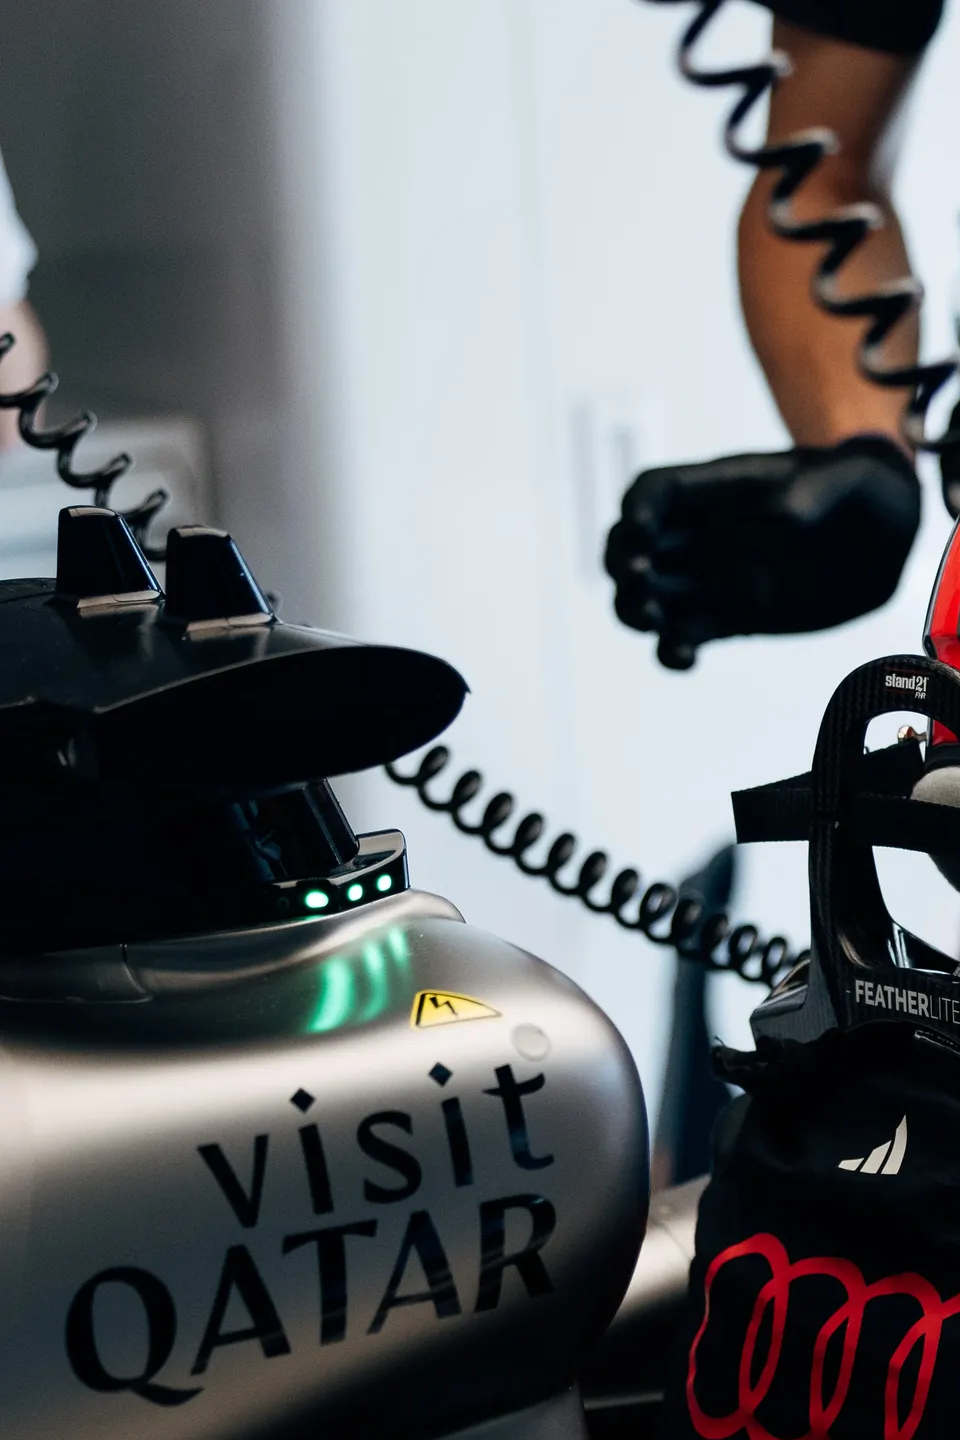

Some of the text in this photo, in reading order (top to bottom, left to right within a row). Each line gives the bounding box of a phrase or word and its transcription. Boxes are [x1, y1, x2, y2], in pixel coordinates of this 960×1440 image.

[885, 673, 928, 692] stand21
[855, 979, 960, 1025] FEATHERLITE
[197, 1062, 555, 1229] visit
[64, 1192, 558, 1407] QATAR
